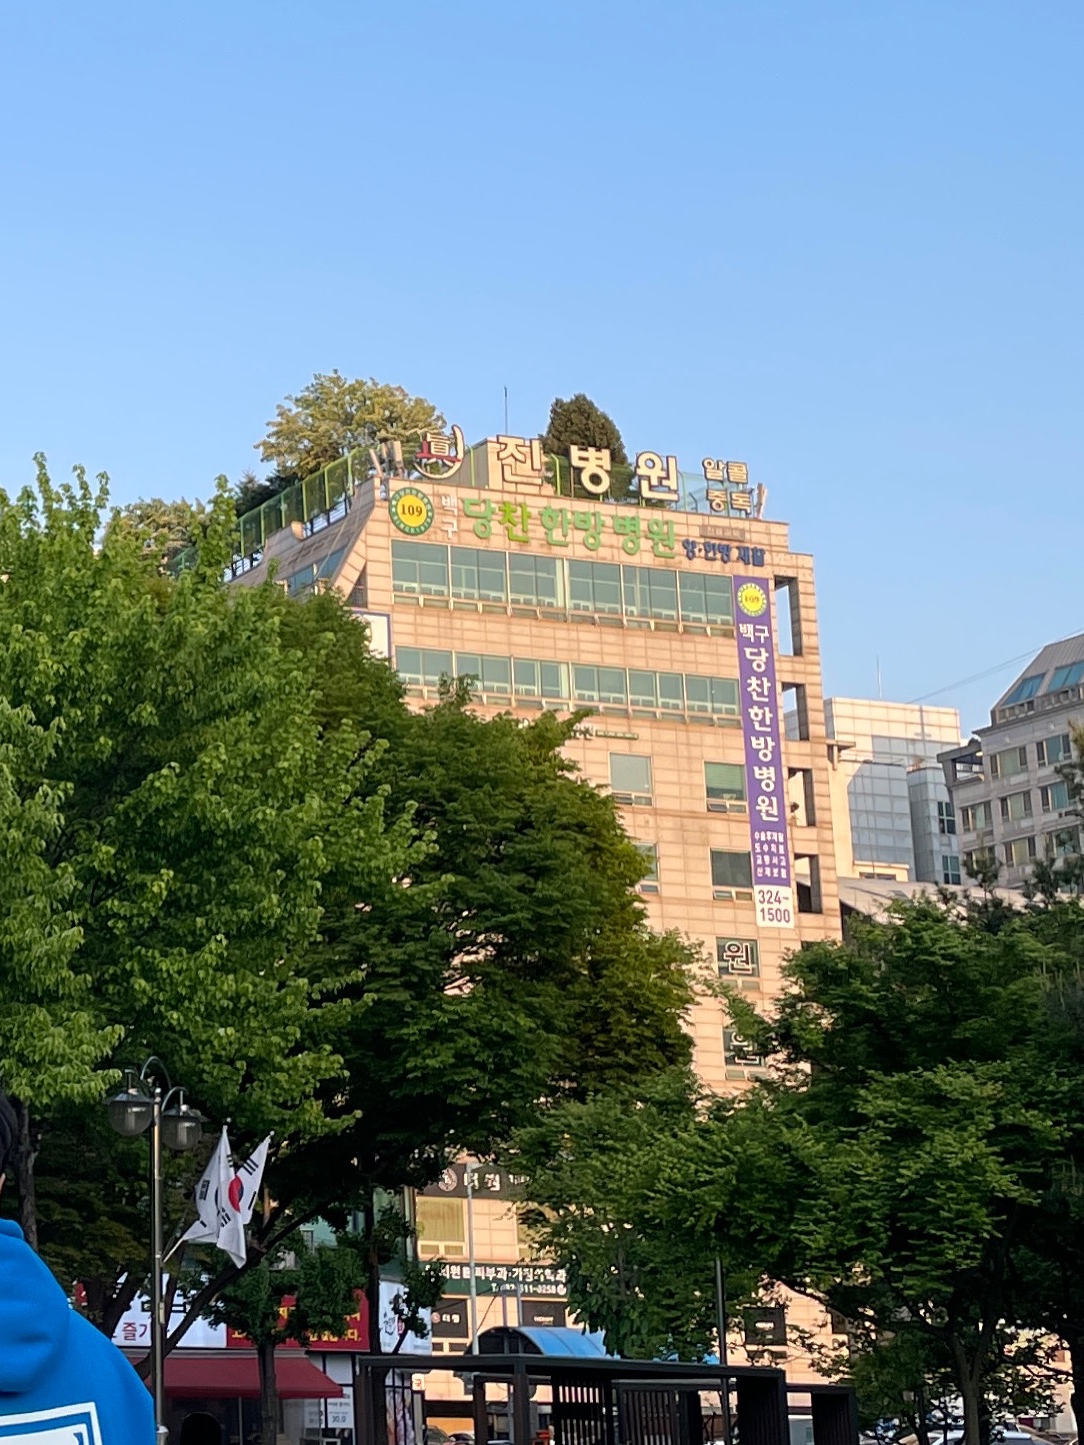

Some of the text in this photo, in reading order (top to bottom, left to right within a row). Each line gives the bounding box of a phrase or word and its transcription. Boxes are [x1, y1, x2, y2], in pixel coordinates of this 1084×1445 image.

[702, 456, 748, 484] 알콜
[400, 503, 423, 517] 109
[706, 488, 752, 514] 중독
[738, 623, 770, 644] 백구
[758, 889, 790, 905] 324-
[759, 907, 791, 924] 1500
[723, 941, 753, 975] 원
